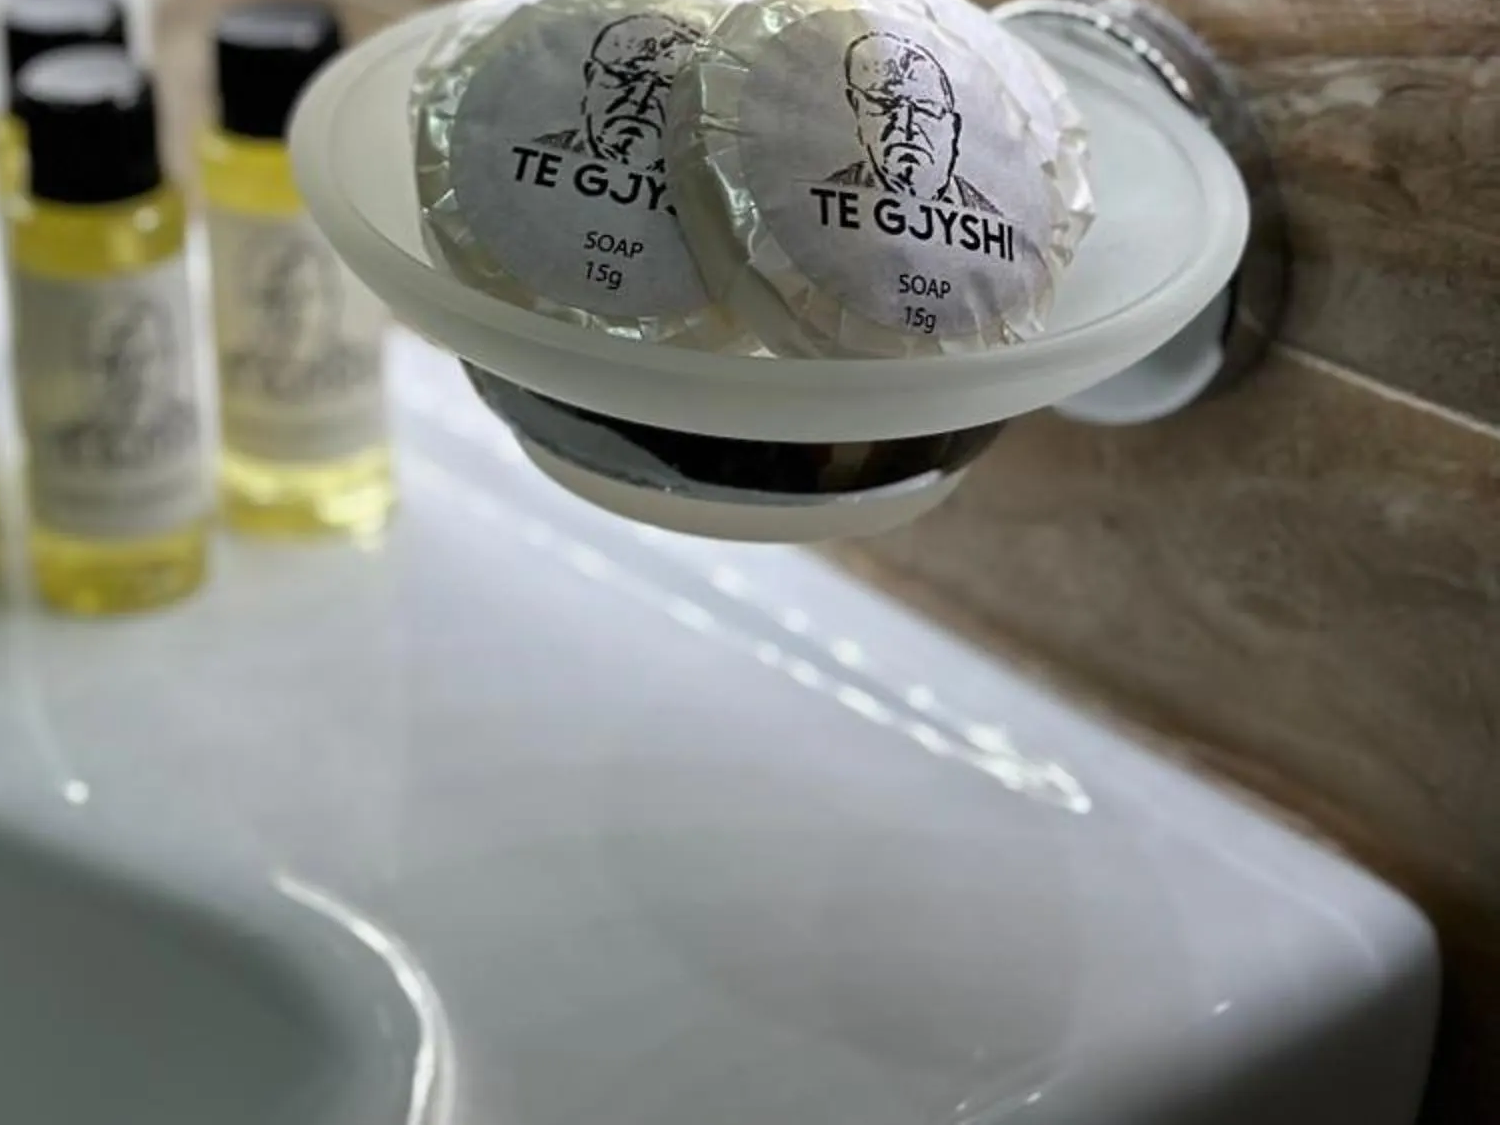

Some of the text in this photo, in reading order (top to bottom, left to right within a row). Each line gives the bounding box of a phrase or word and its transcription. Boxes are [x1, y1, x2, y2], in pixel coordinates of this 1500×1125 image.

[512, 146, 678, 216] TE GJY
[810, 188, 1014, 262] TE GJYSHI
[583, 230, 644, 259] SOAP
[585, 261, 622, 291] 15g
[898, 274, 951, 300] SOAP
[903, 305, 937, 334] 15g
